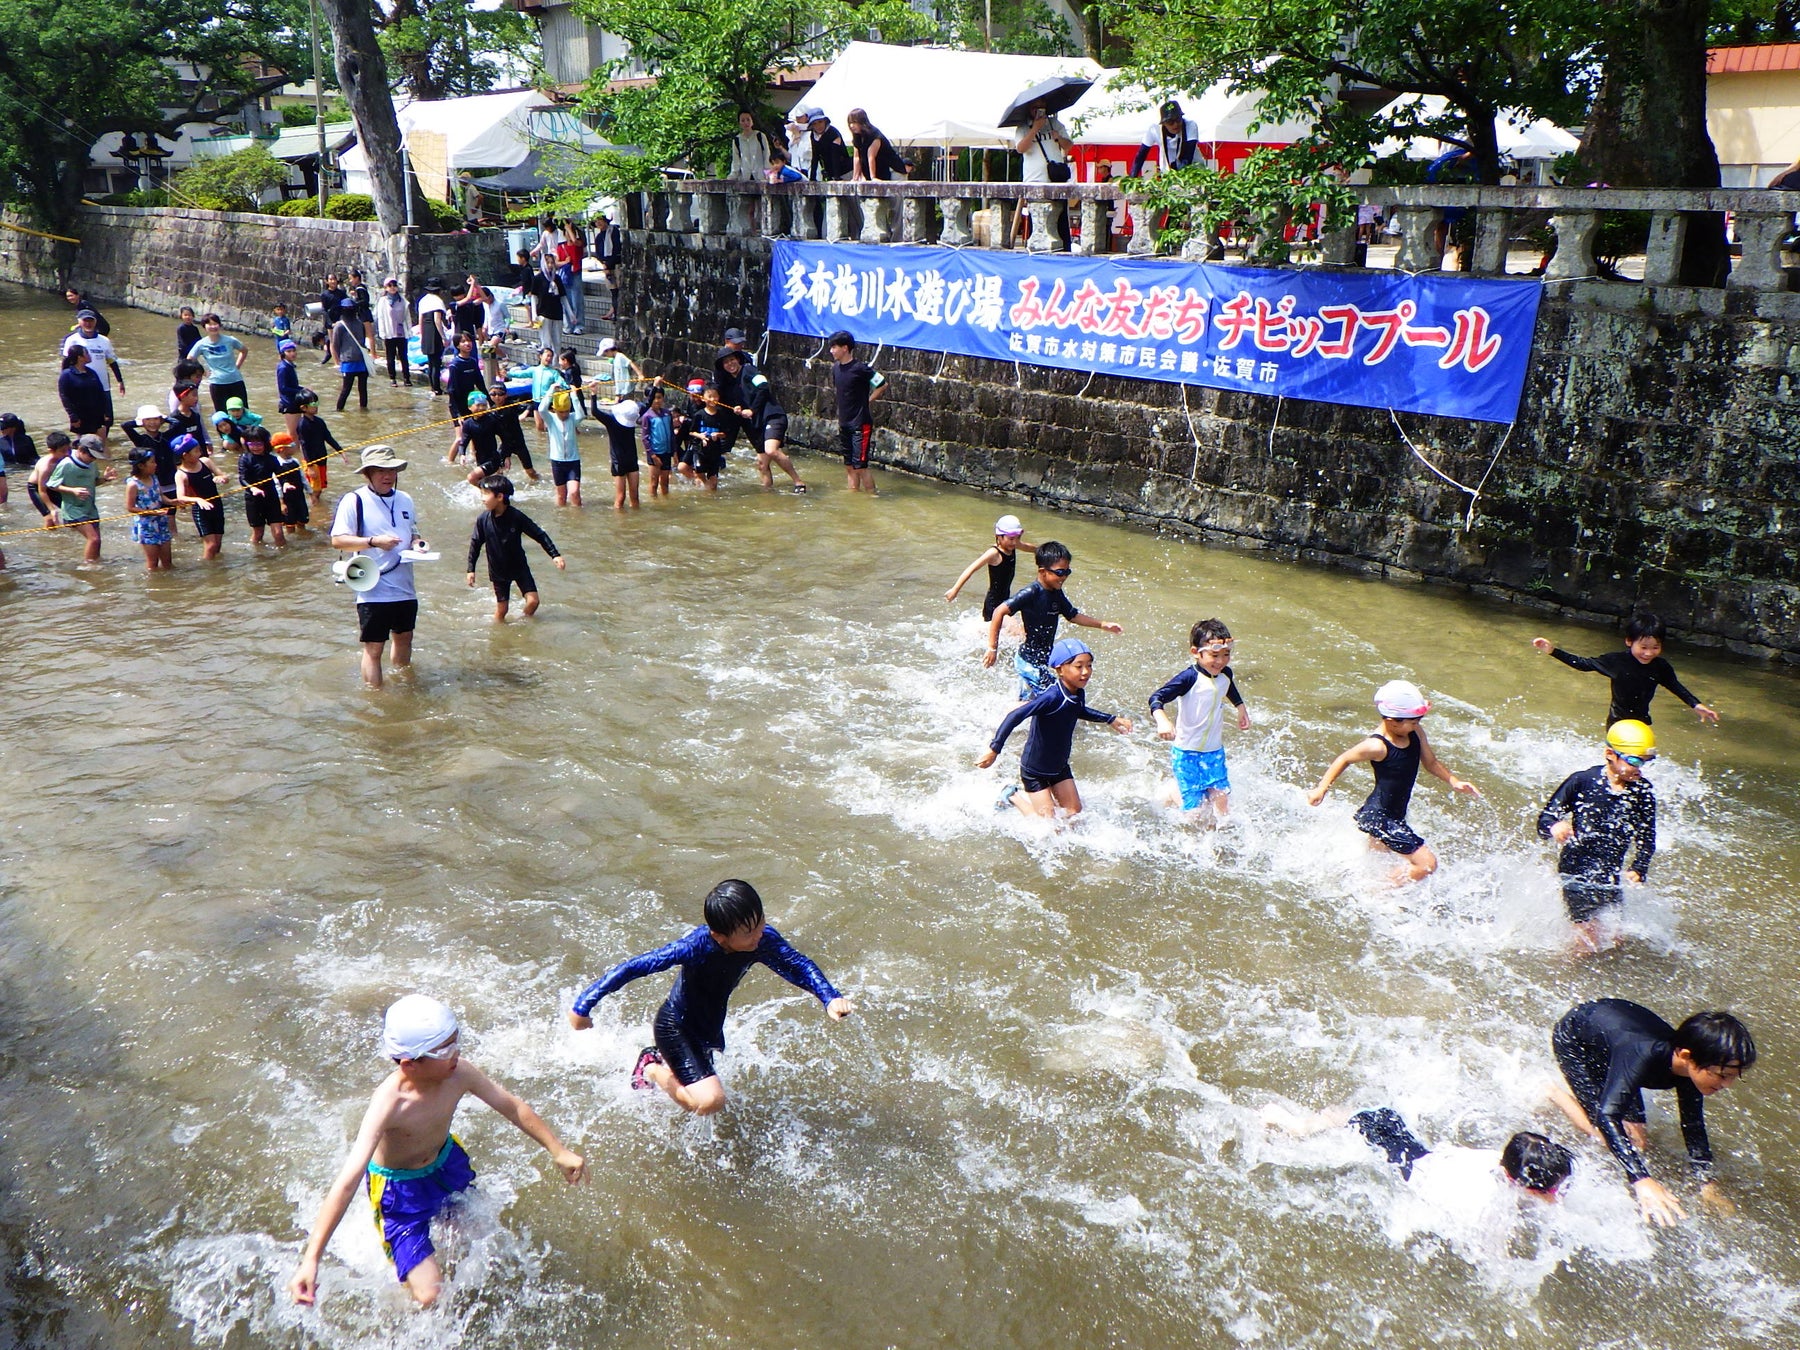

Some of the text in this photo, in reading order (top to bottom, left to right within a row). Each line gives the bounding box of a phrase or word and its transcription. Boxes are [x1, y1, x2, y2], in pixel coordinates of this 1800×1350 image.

[782, 260, 1502, 374] 多布施川水遊び場 みんな友だち チビッコプール
